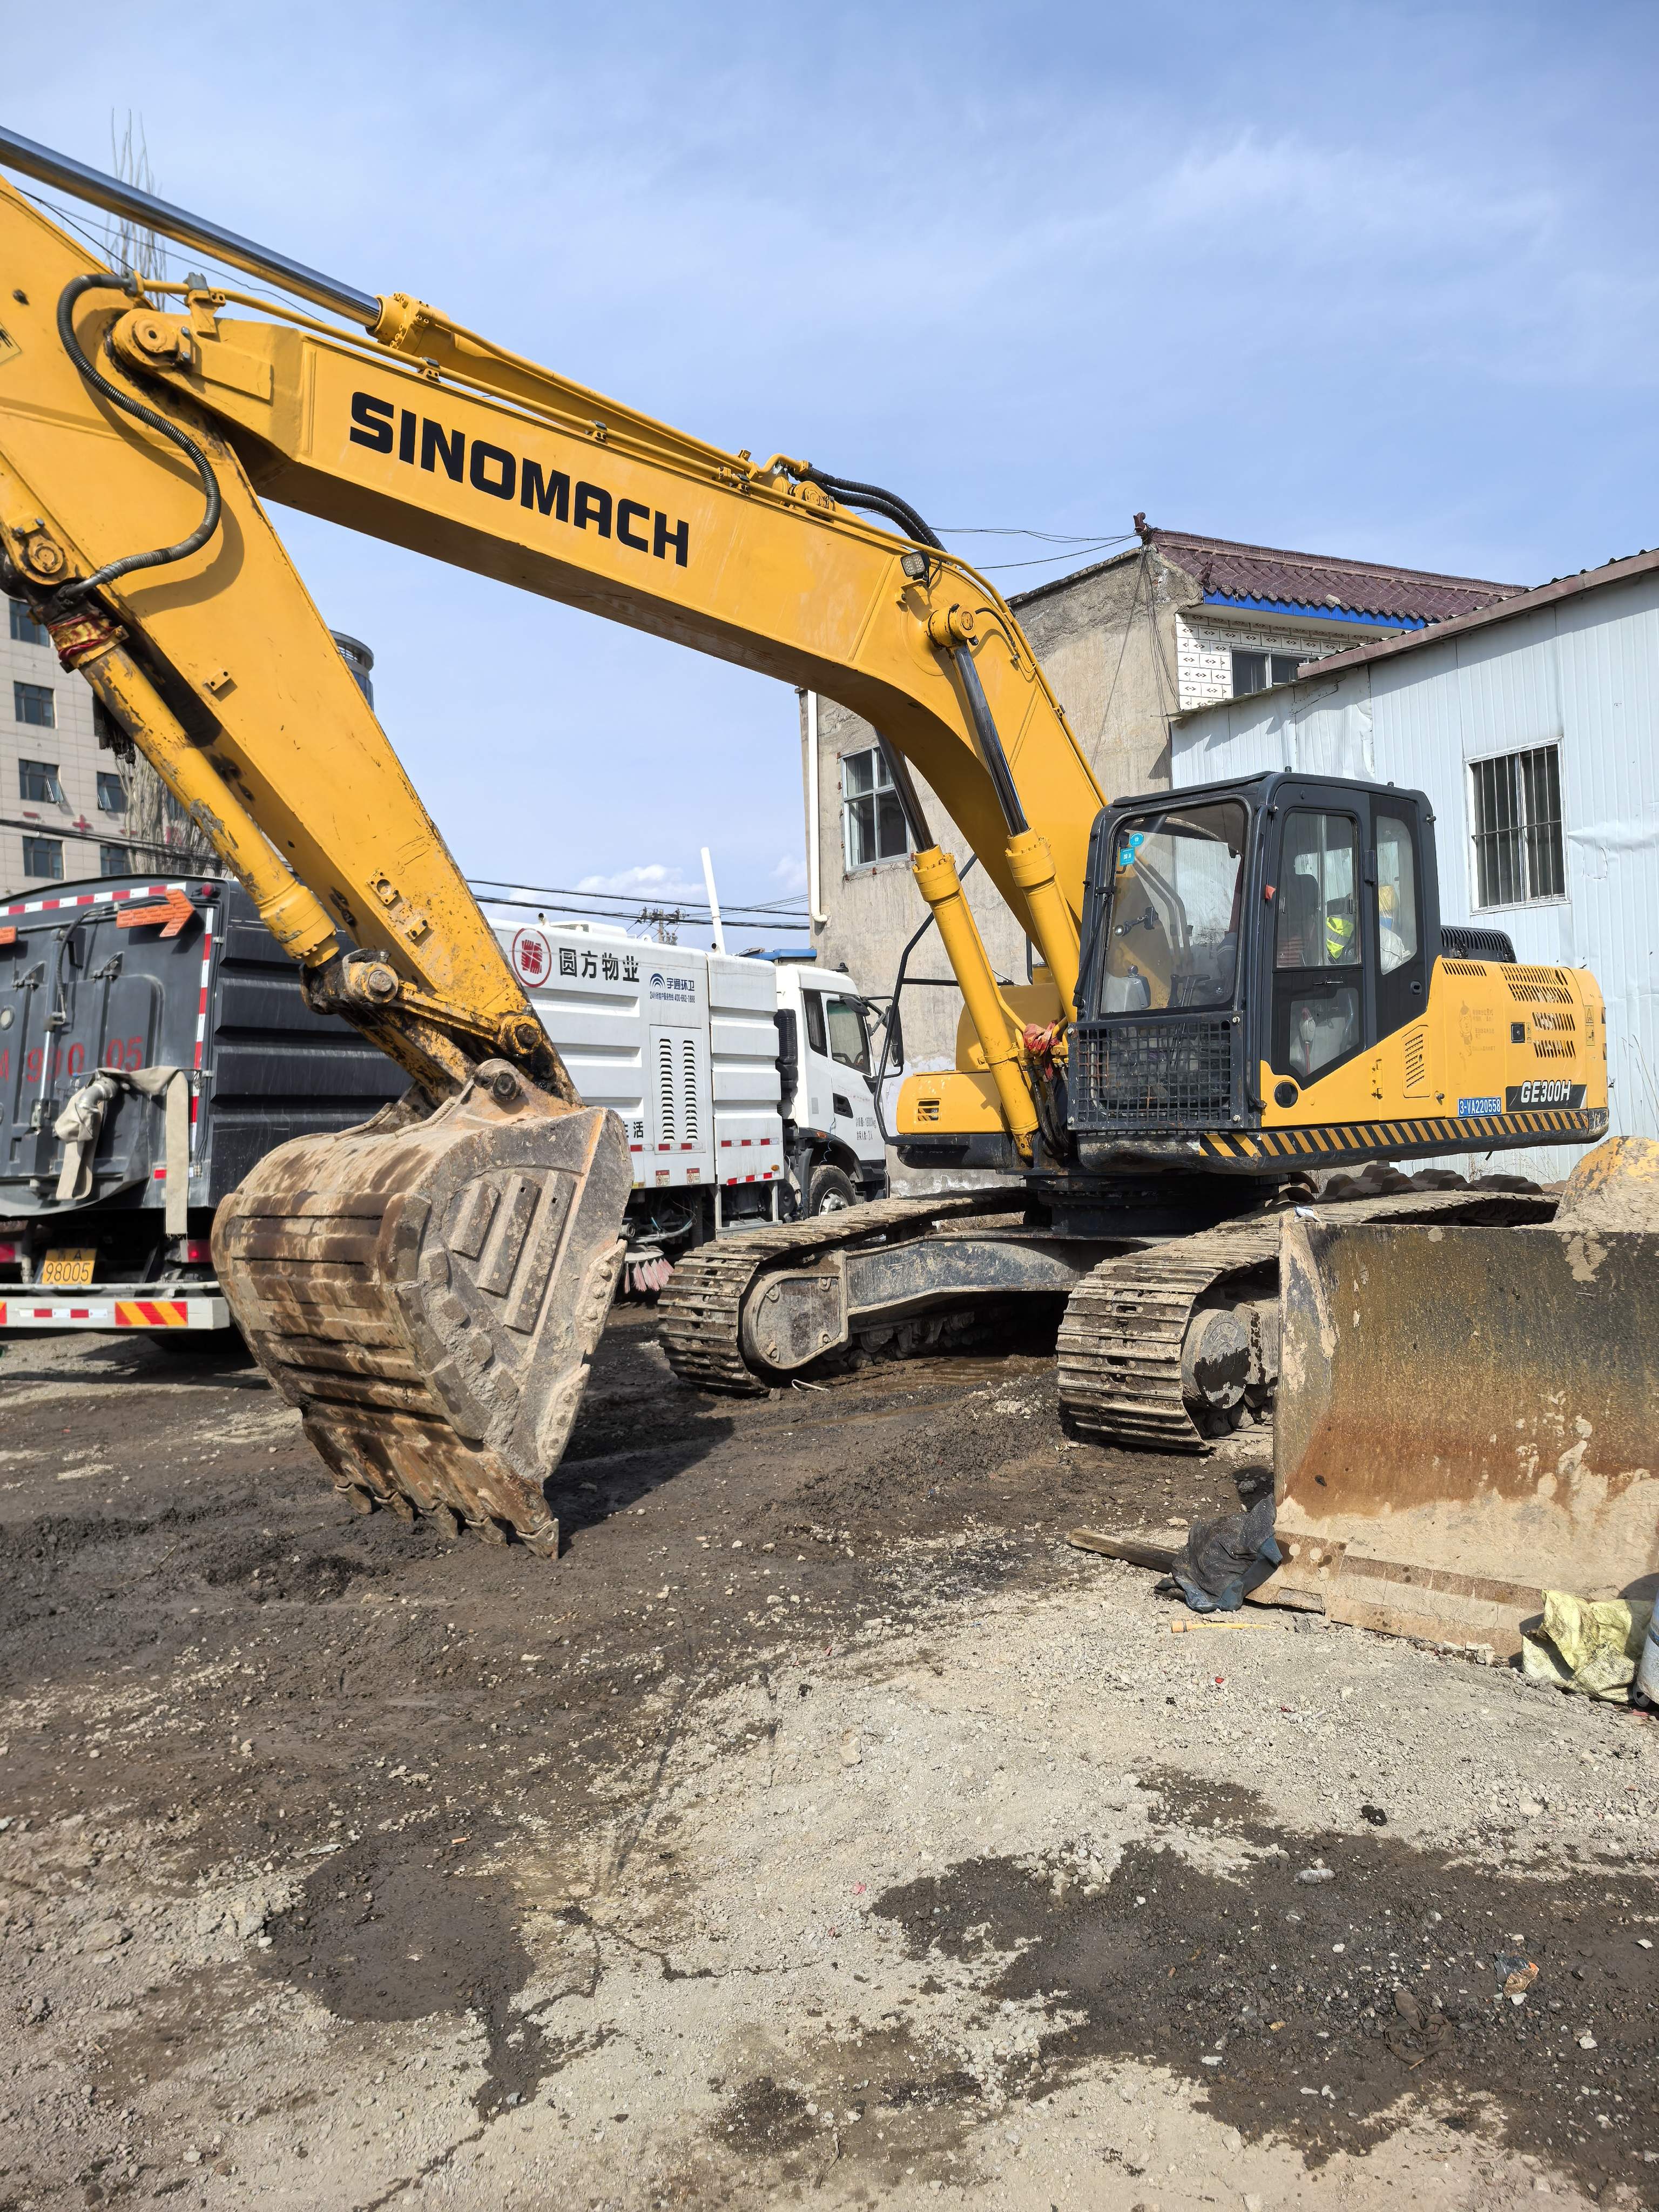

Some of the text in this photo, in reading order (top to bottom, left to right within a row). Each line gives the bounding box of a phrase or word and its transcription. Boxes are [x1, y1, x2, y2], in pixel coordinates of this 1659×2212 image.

[349, 391, 689, 568] SINOMACH
[559, 947, 639, 983] 圆方物业
[666, 977, 695, 992] 宇通环卫
[1520, 1080, 1571, 1103] GE300H
[1460, 1098, 1501, 1115] 3-VA220558
[46, 1262, 91, 1282] 98005
